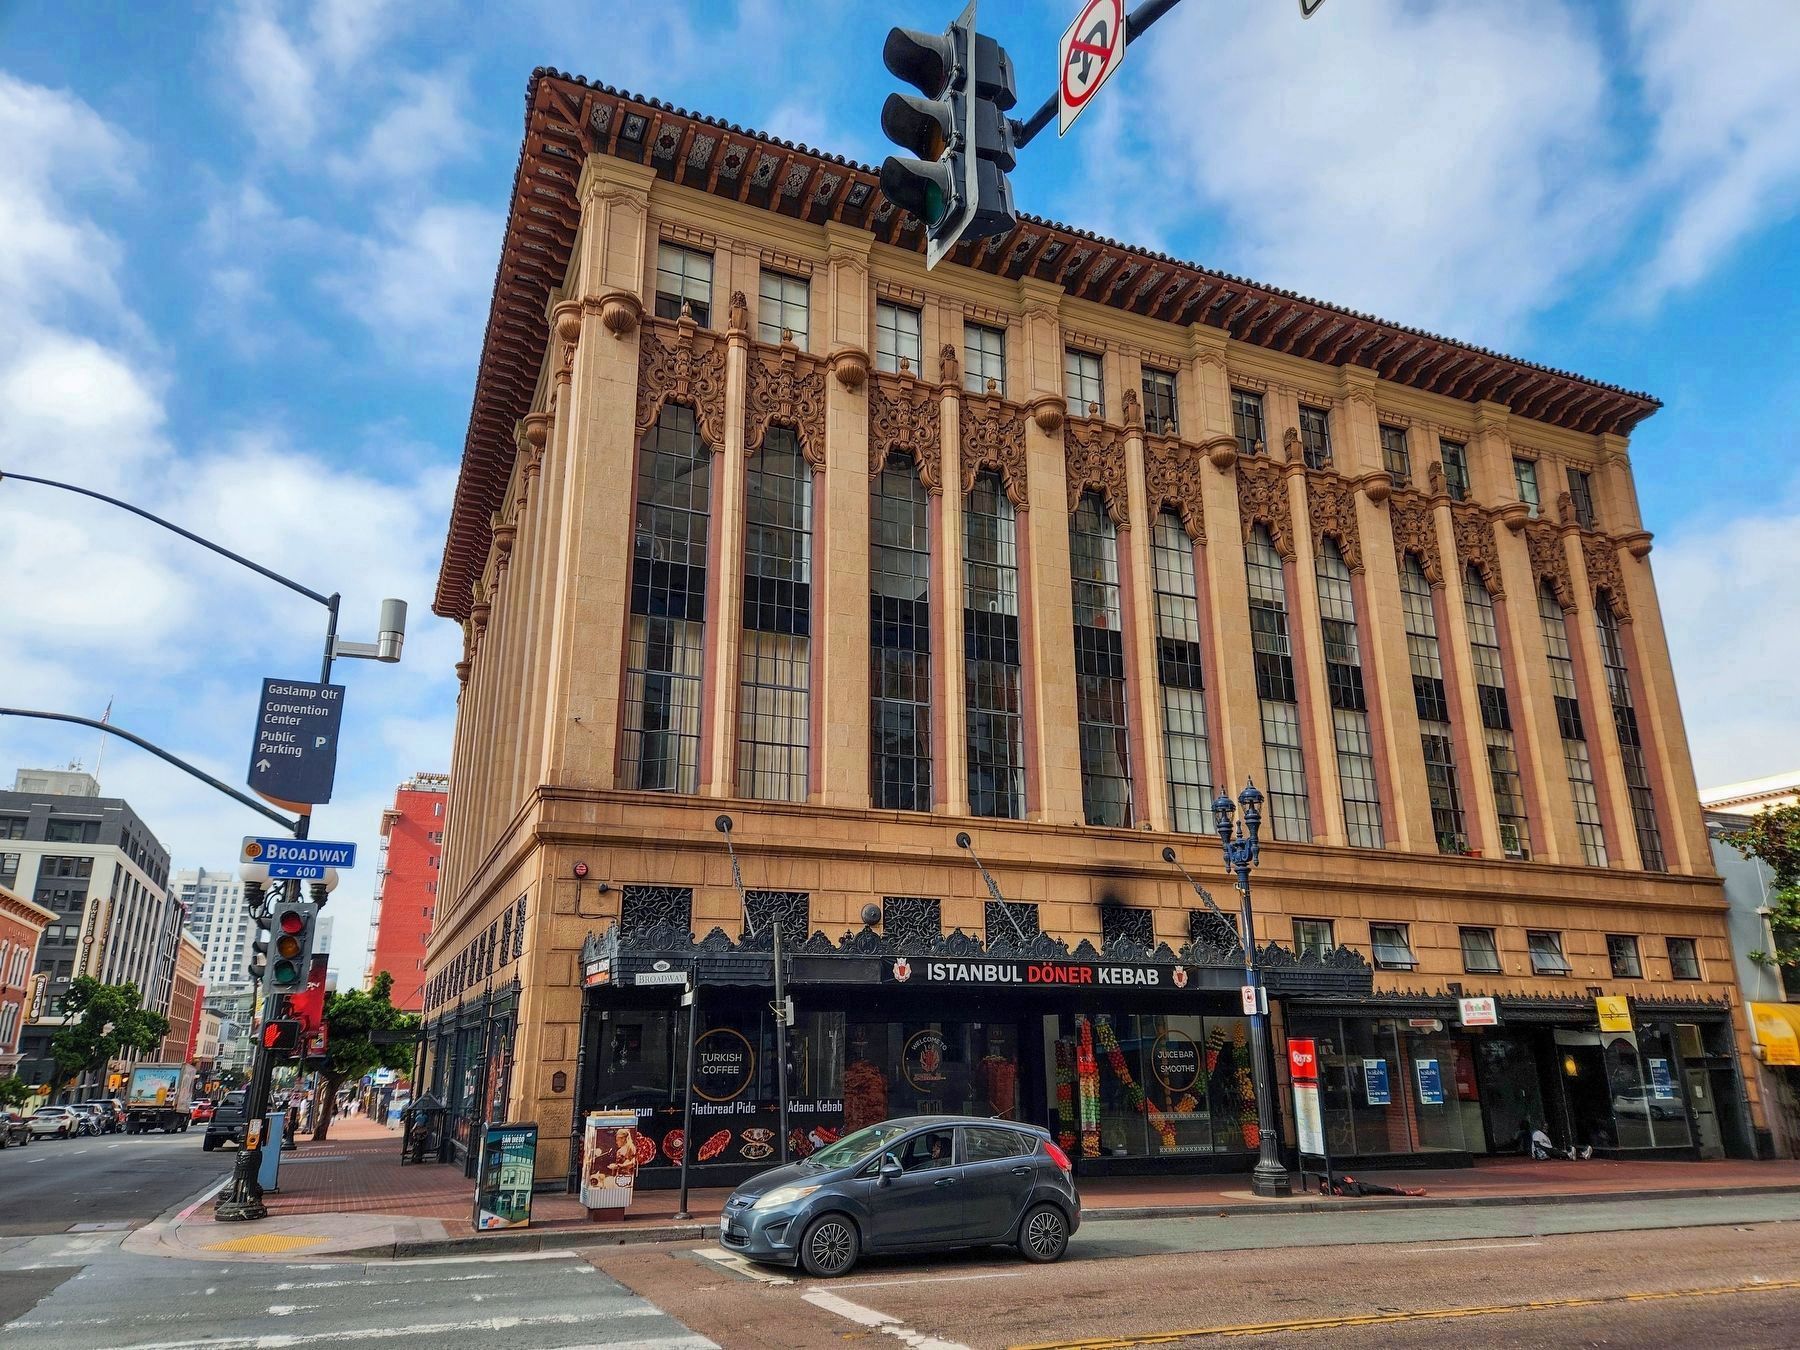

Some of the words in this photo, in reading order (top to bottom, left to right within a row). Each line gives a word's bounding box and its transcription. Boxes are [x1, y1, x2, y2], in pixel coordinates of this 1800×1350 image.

[268, 684, 316, 699] Gaslamp
[321, 687, 338, 700] Qtr
[266, 702, 328, 716] Convention
[264, 714, 302, 726] Center
[261, 731, 296, 743] Public
[259, 743, 302, 758] Parking
[266, 844, 348, 863] BROADWAY
[296, 866, 316, 878] 600
[638, 974, 684, 984] BROADWAY
[927, 963, 1022, 982] ISTANBUL
[1028, 962, 1092, 984] DÖNER
[1098, 968, 1160, 985] KEBAB
[911, 1037, 940, 1050] WELCOME
[701, 1053, 742, 1062] TURKISH
[1157, 1050, 1178, 1059] JUICE
[702, 1066, 740, 1074] COFFEE
[691, 1102, 734, 1115] Flatbread
[736, 1102, 756, 1114] Pide
[788, 1101, 814, 1112] Adana
[816, 1100, 843, 1112] Kebab
